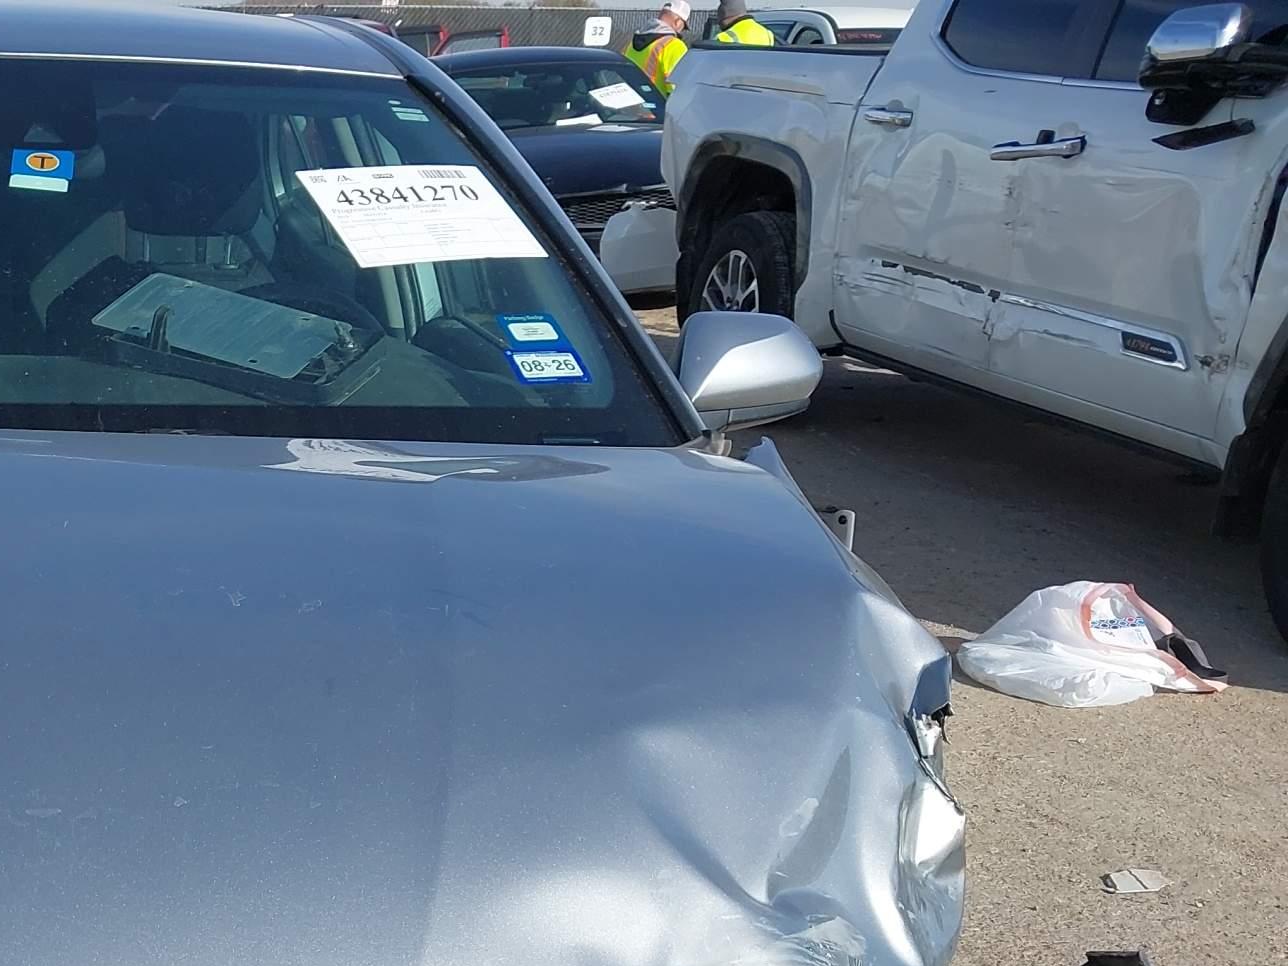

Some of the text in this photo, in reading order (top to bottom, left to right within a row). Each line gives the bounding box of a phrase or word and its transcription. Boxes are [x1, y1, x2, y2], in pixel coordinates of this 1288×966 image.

[591, 26, 605, 36] 32
[32, 155, 55, 169] T
[336, 184, 480, 207] 43841270
